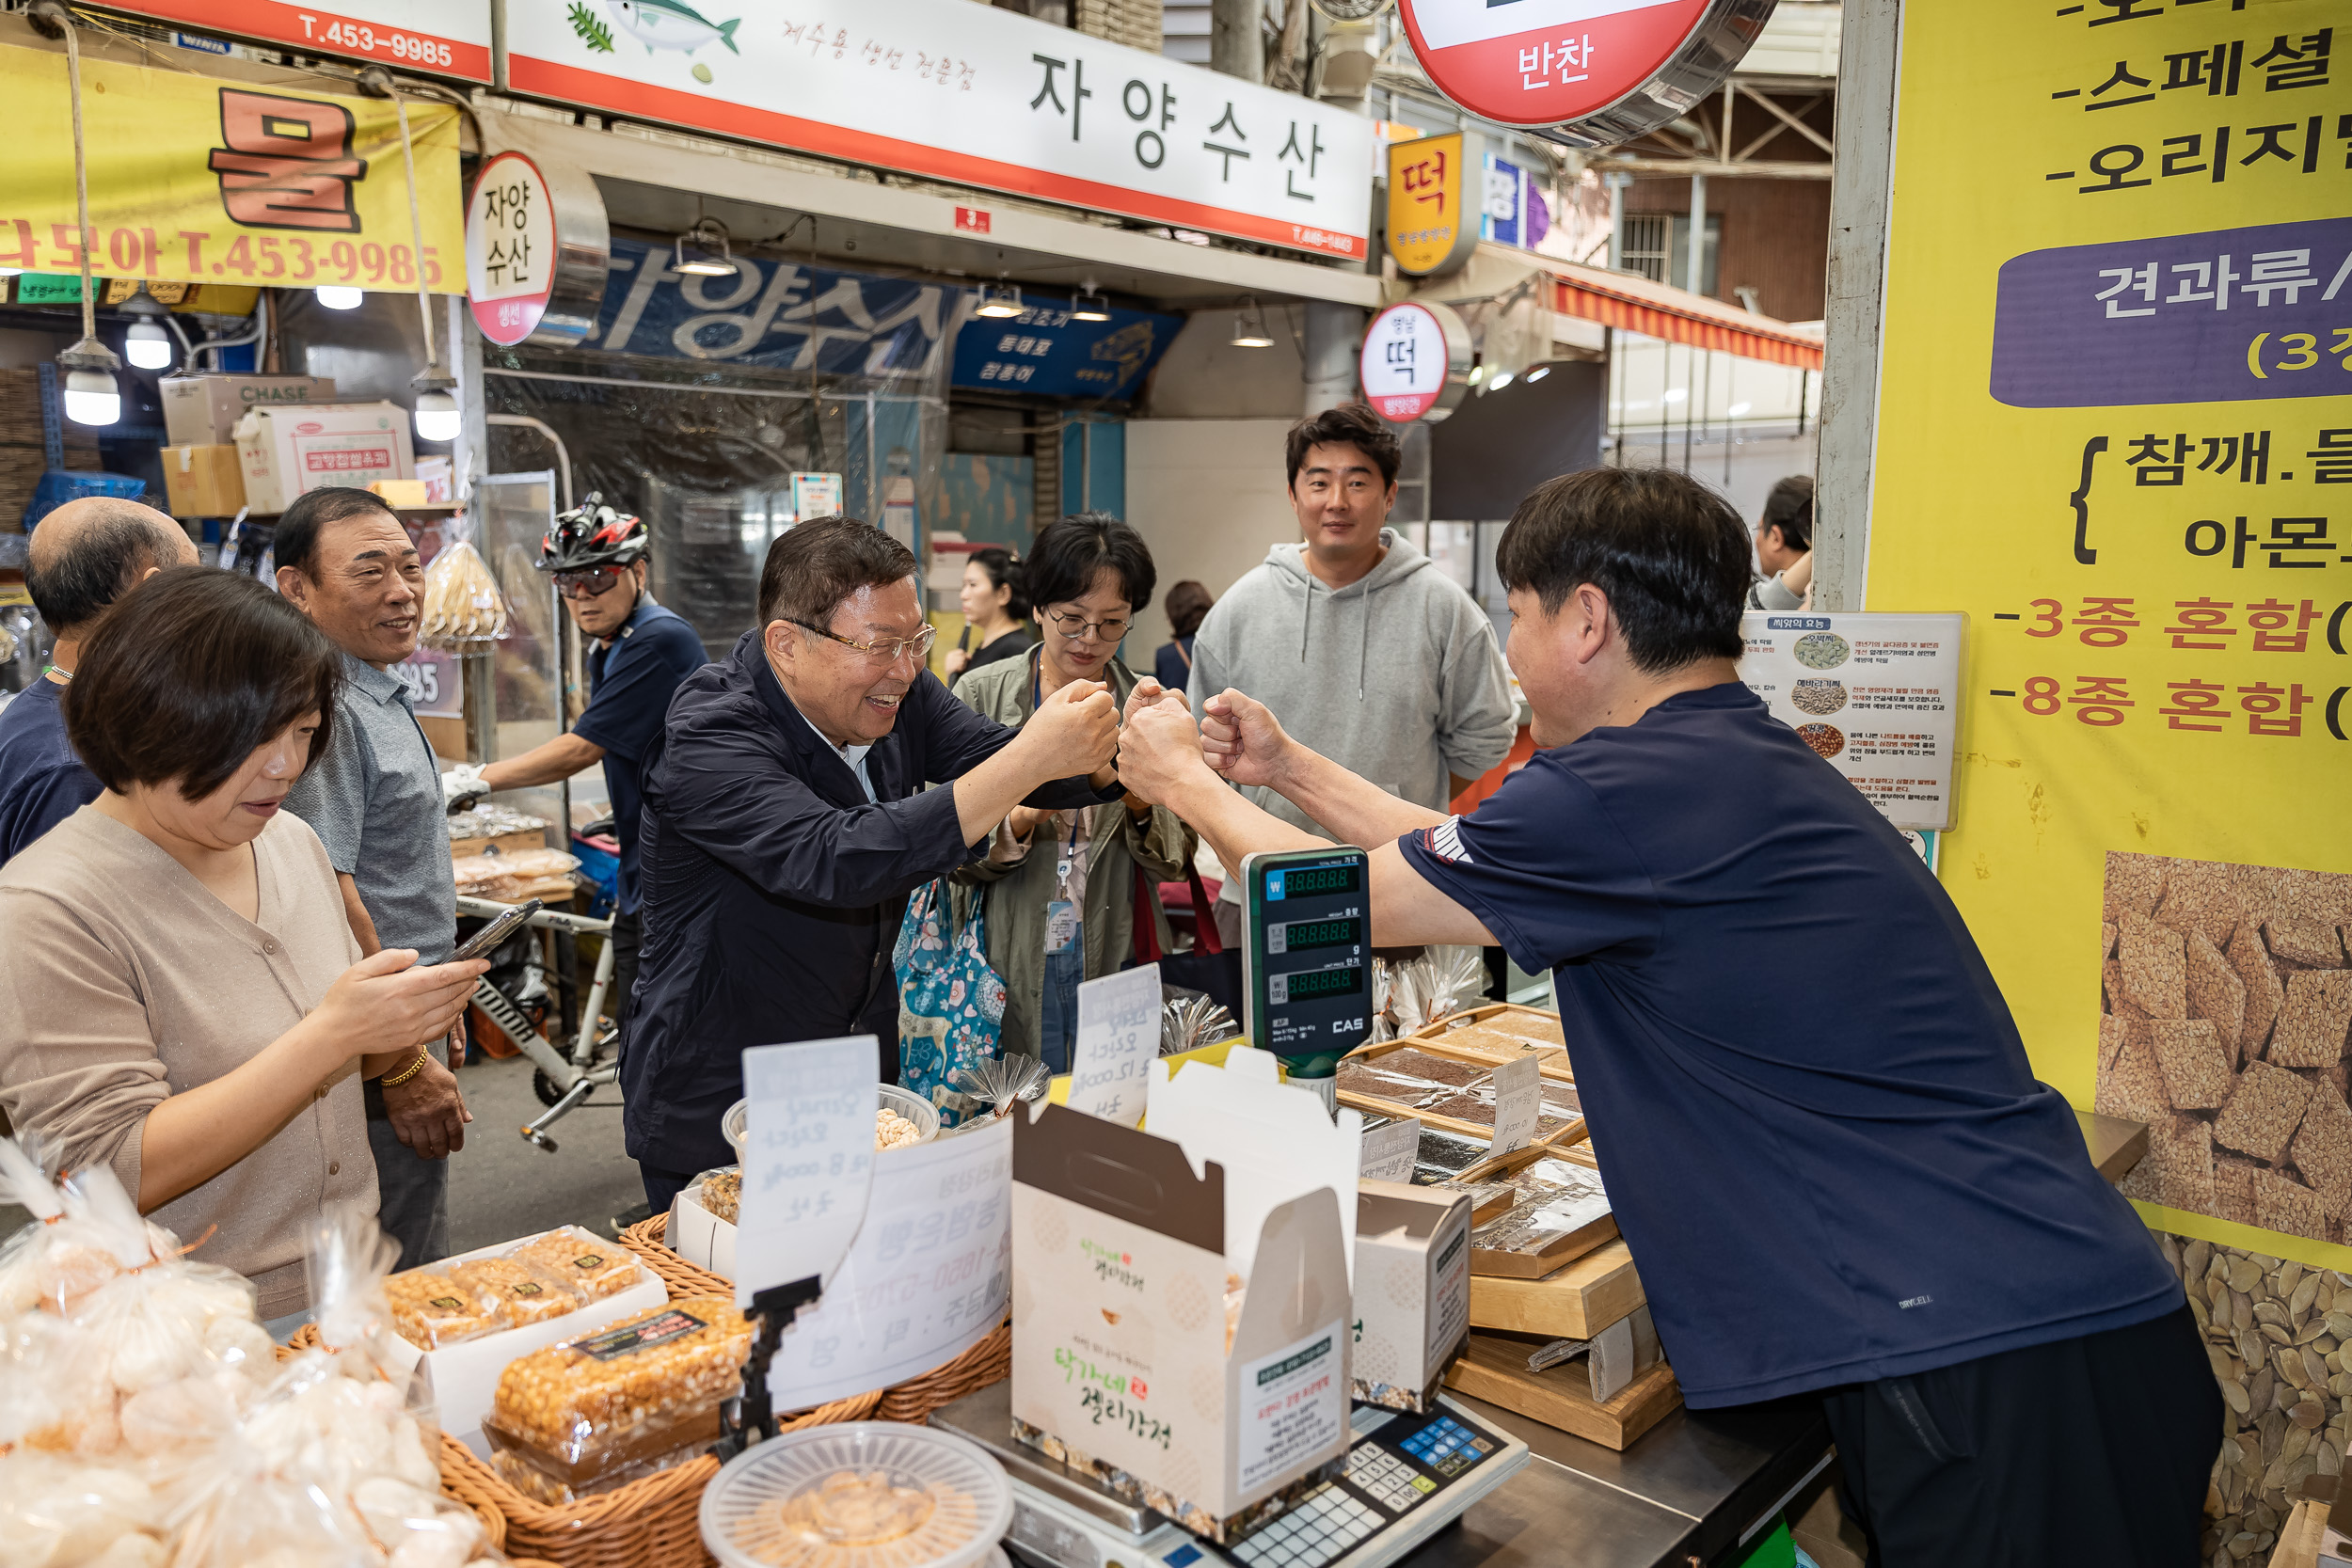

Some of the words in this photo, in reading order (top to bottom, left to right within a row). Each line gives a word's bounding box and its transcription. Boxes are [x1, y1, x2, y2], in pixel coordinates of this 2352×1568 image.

[297, 13, 453, 68] T.453-9985
[783, 20, 849, 61] 제수용
[861, 38, 903, 71] 생선
[914, 51, 977, 91] 전문점
[1518, 34, 1594, 90] 반찬
[2051, 27, 2333, 112] -스페셜
[1031, 53, 1325, 200] 자양수산
[208, 87, 368, 234] 몰
[1401, 150, 1446, 218] 떡
[485, 179, 531, 230] 자양
[179, 230, 442, 285] T.453-9985
[485, 233, 531, 286] 수산
[497, 303, 521, 327] 생선
[1386, 338, 1416, 387] 떡
[240, 385, 309, 403] CHASE
[2185, 516, 2352, 568] 아몬
[1772, 618, 1802, 628] 씨앗의
[1805, 619, 1824, 628] 효능
[1994, 595, 2140, 648] -3종
[1796, 678, 1841, 689] 해바라기씨
[1907, 695, 1942, 704] 보호합니다.
[1990, 675, 2135, 726] -8종
[1353, 945, 1359, 956] g
[1333, 1018, 1363, 1034] CAS
[1081, 1386, 1171, 1451] 젤리강정
